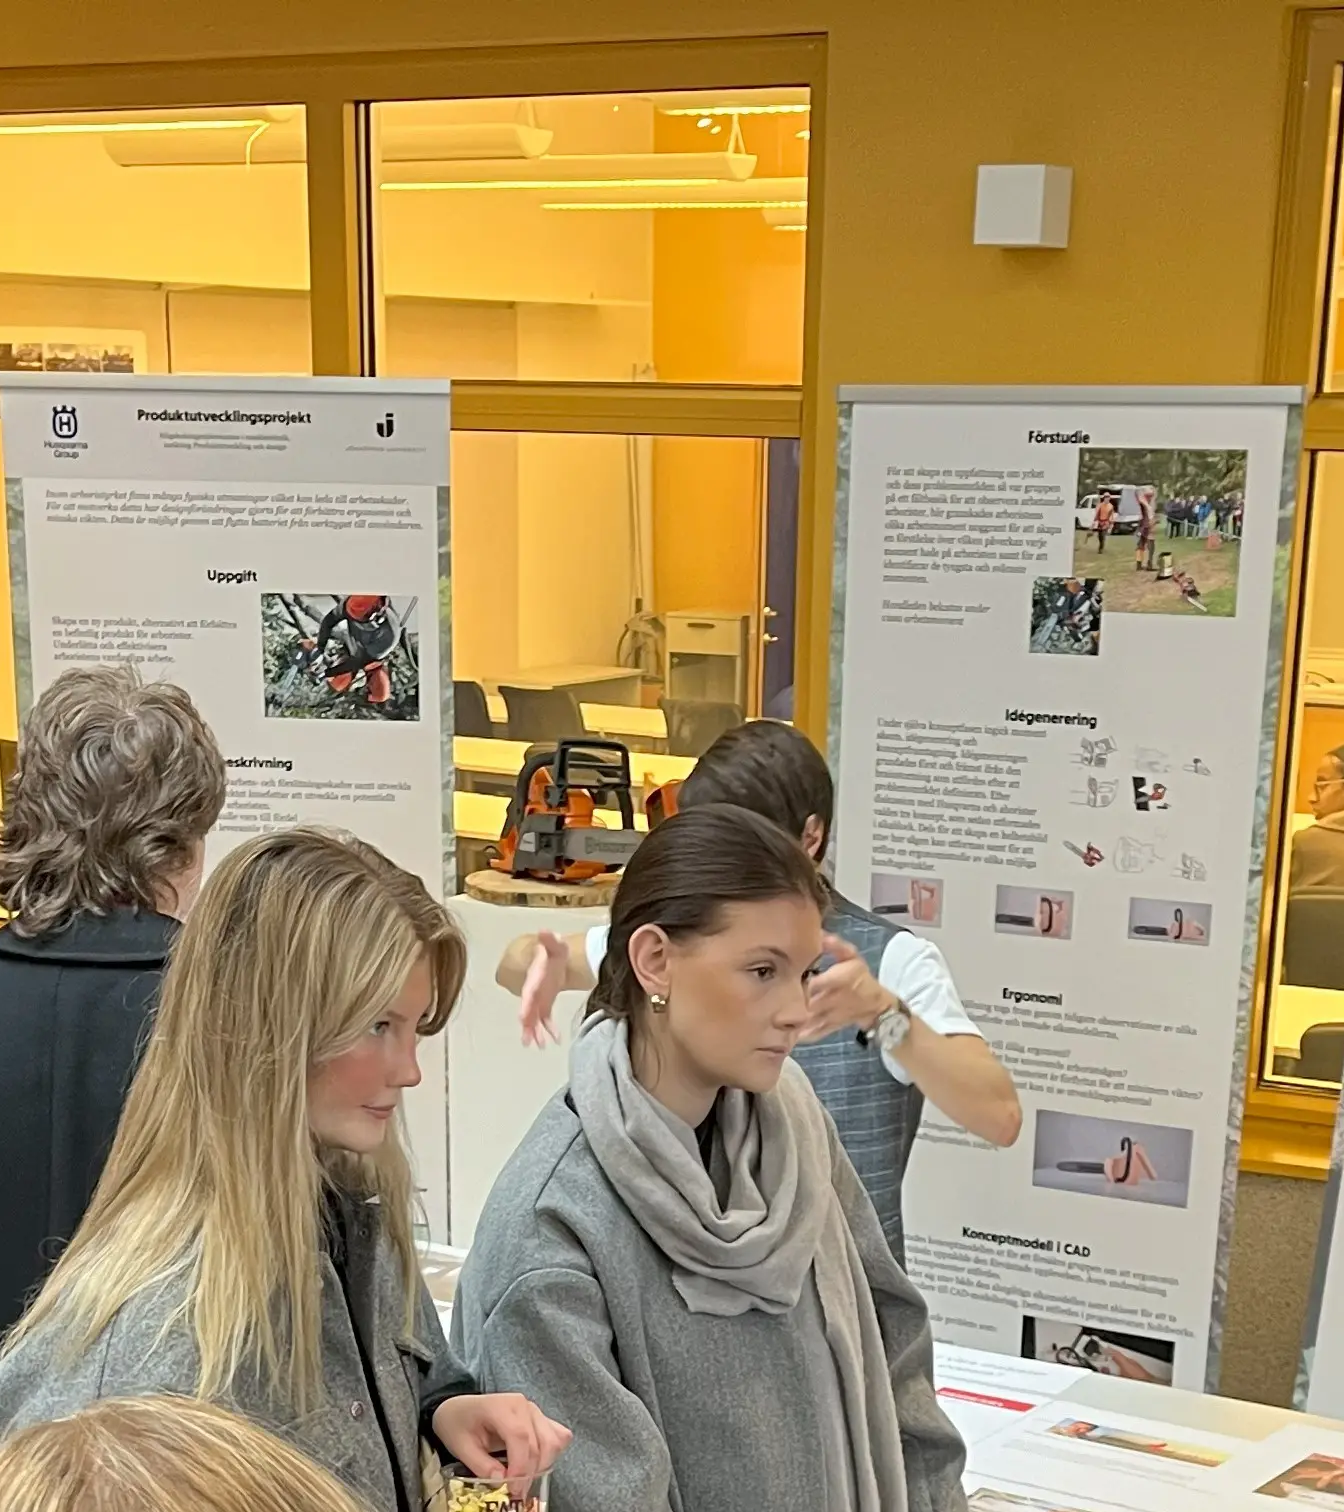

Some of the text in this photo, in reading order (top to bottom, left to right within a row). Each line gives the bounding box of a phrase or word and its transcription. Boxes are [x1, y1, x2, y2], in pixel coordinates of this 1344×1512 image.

[137, 408, 312, 426] Produktutvecklingsprojekt
[1028, 430, 1091, 444] Förstudie
[207, 569, 258, 584] Uppgift
[1005, 709, 1097, 729] Idégenerering
[226, 756, 293, 771] eskrivning
[1002, 987, 1063, 1006] Ergonomi
[962, 1226, 1054, 1252] Konceptmodell
[1064, 1243, 1091, 1258] CAD
